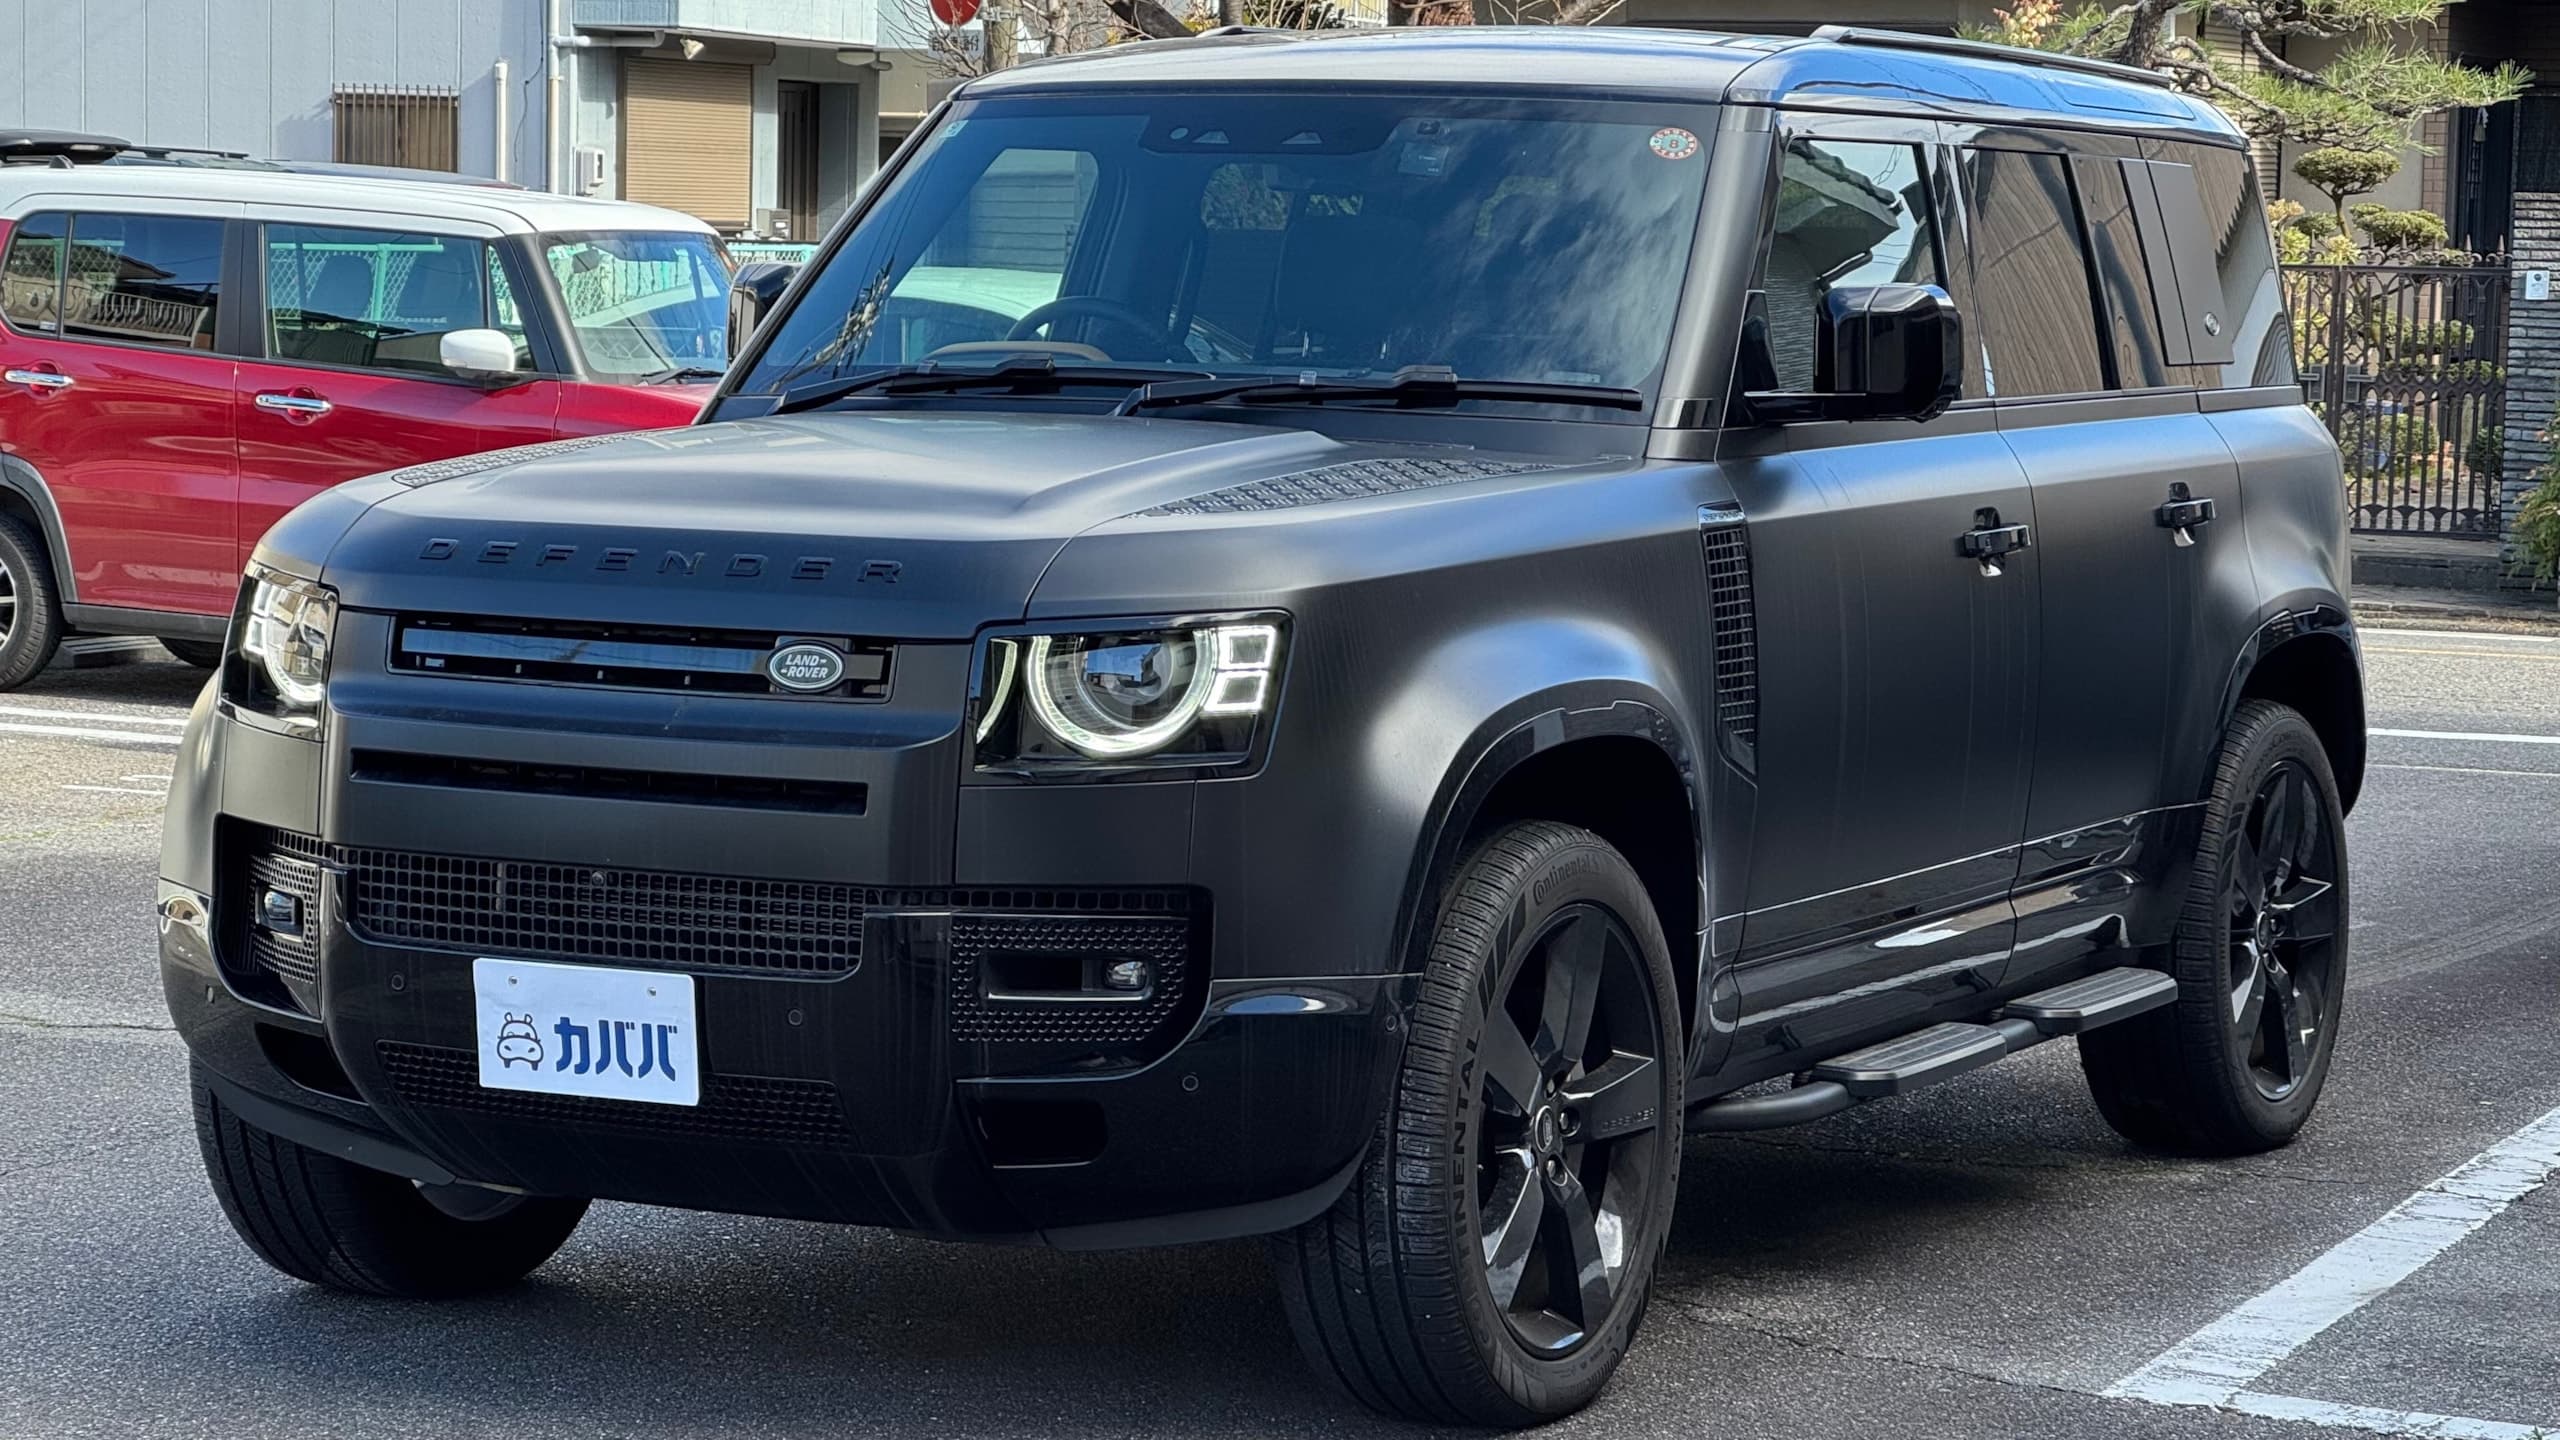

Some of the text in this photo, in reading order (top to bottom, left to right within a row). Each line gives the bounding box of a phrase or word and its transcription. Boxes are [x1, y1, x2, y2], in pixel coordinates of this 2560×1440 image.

[419, 537, 903, 584] DEFENDER
[1532, 854, 1591, 906] Continental
[554, 1016, 678, 1082] カババ
